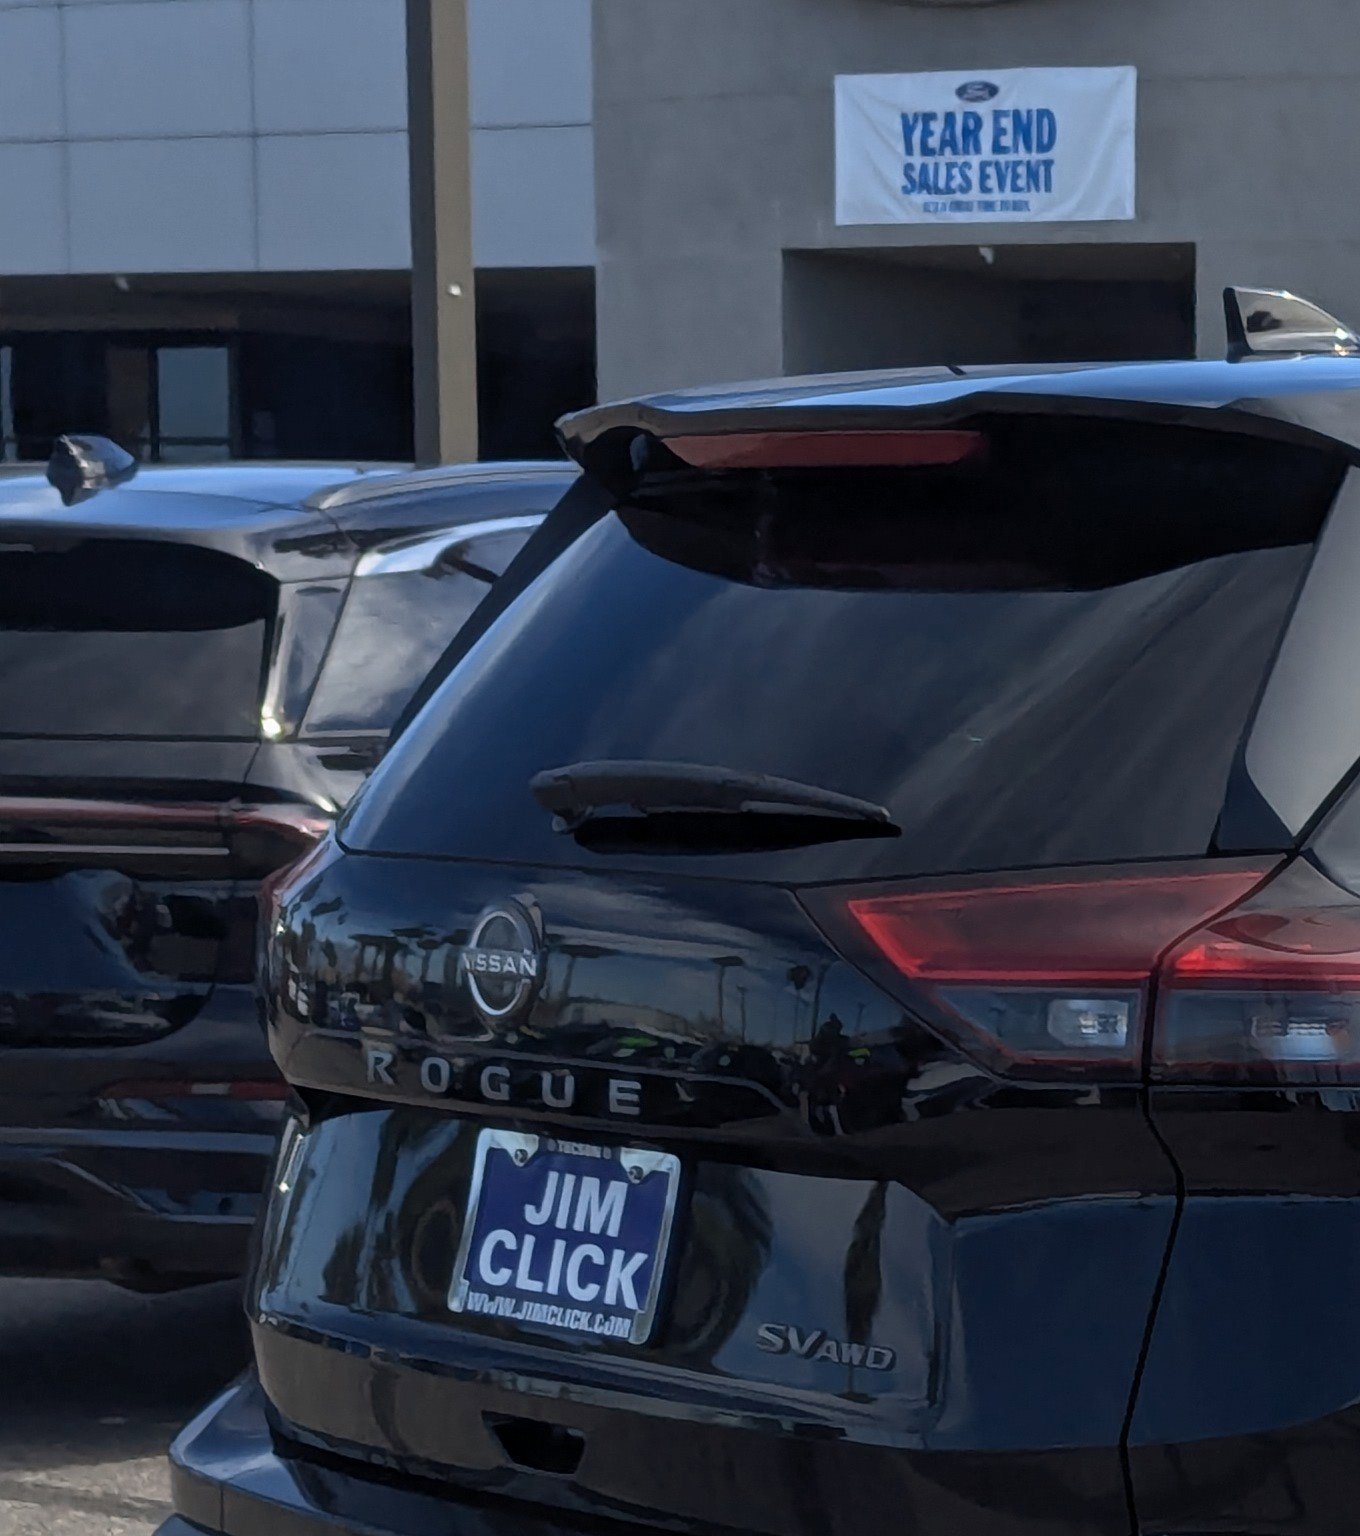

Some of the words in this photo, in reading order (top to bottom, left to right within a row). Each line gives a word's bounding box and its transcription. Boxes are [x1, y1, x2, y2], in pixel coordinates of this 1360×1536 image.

[900, 110, 983, 157] YEAR
[992, 108, 1057, 154] END
[901, 160, 973, 196] SALES
[979, 159, 1055, 193] EVENT
[462, 951, 537, 977] NISSAN
[367, 1050, 642, 1115] ROGUE
[524, 1171, 629, 1238] JIM
[479, 1229, 649, 1311] CLICK
[757, 1323, 824, 1356] SV
